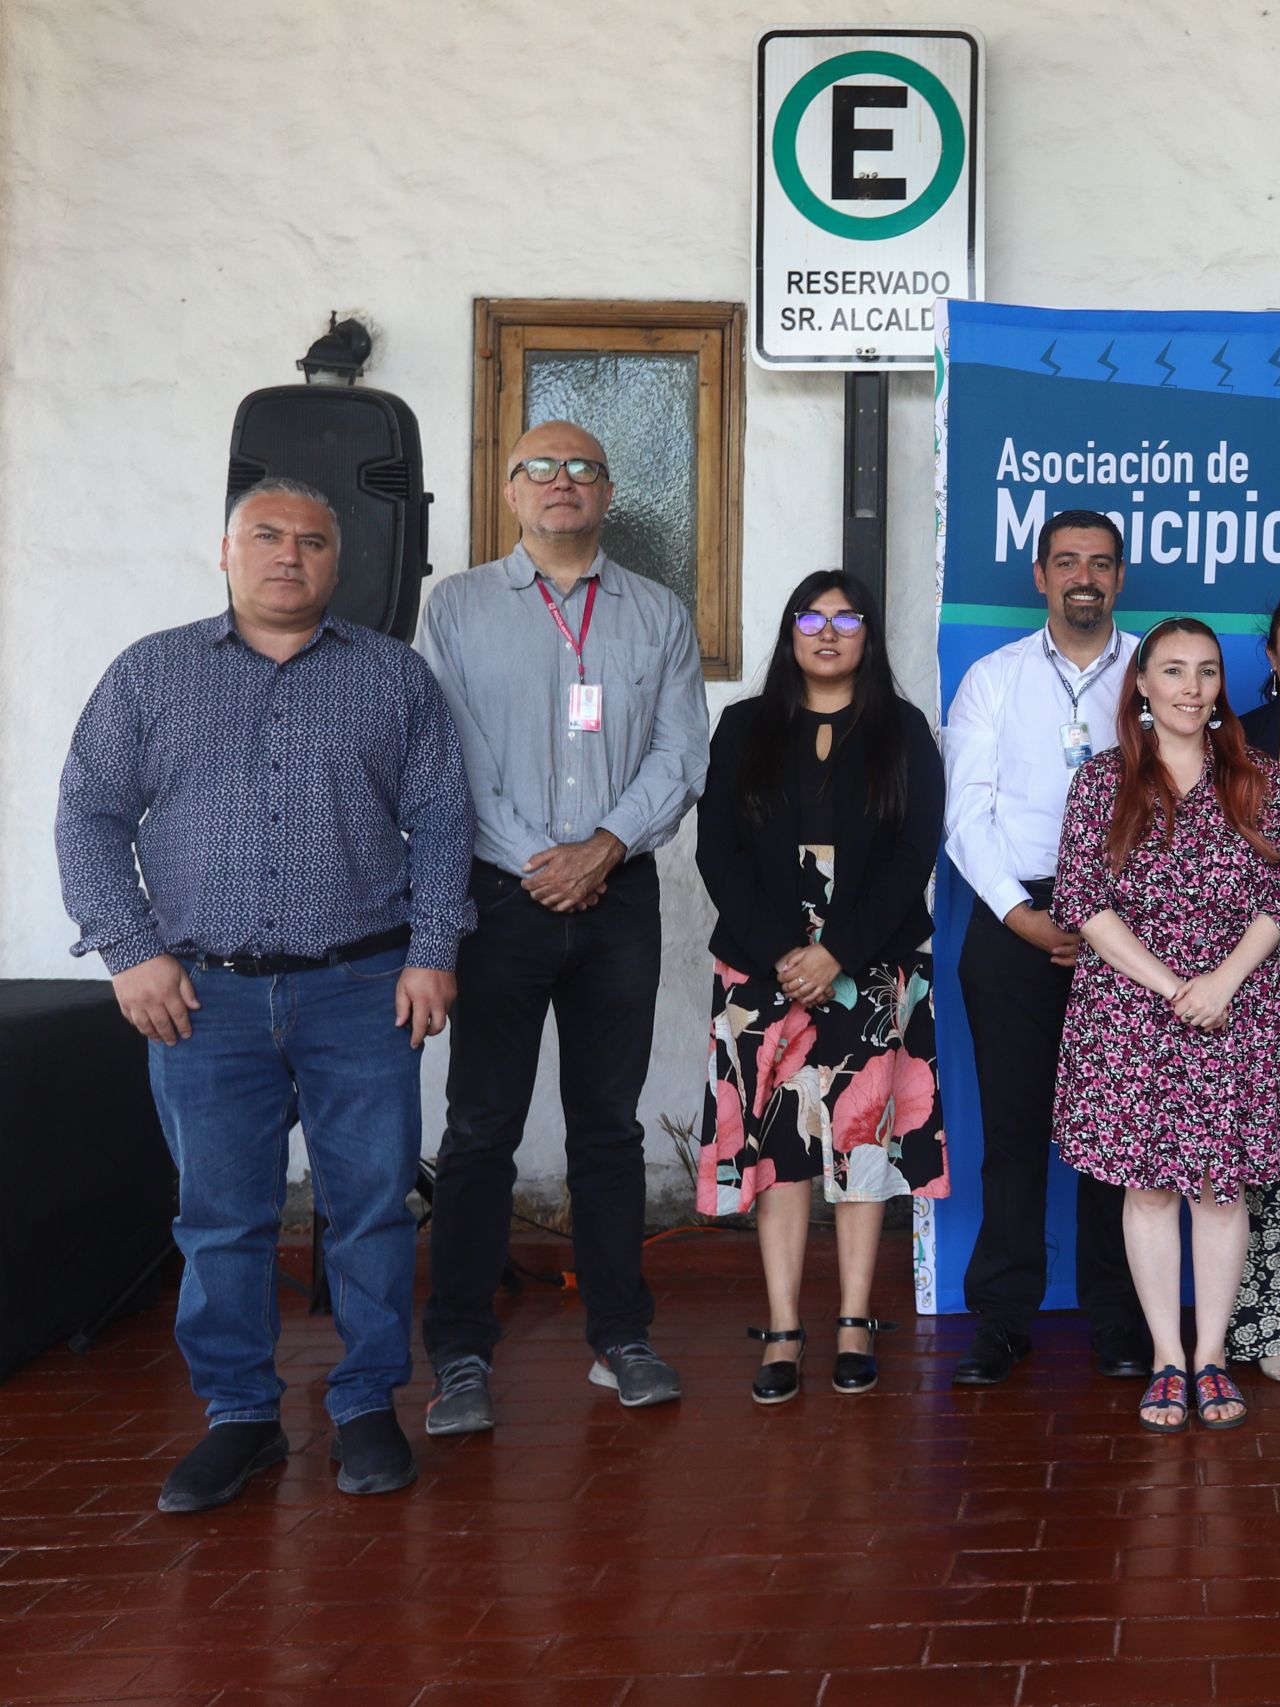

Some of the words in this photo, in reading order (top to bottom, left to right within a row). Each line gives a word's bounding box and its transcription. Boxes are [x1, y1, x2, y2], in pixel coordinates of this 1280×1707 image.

[831, 85, 908, 201] E
[787, 270, 950, 295] RESERVADO
[780, 307, 822, 331] SR.
[830, 307, 935, 331] ALCALD
[996, 437, 1197, 484] Asociación
[1206, 440, 1250, 484] de
